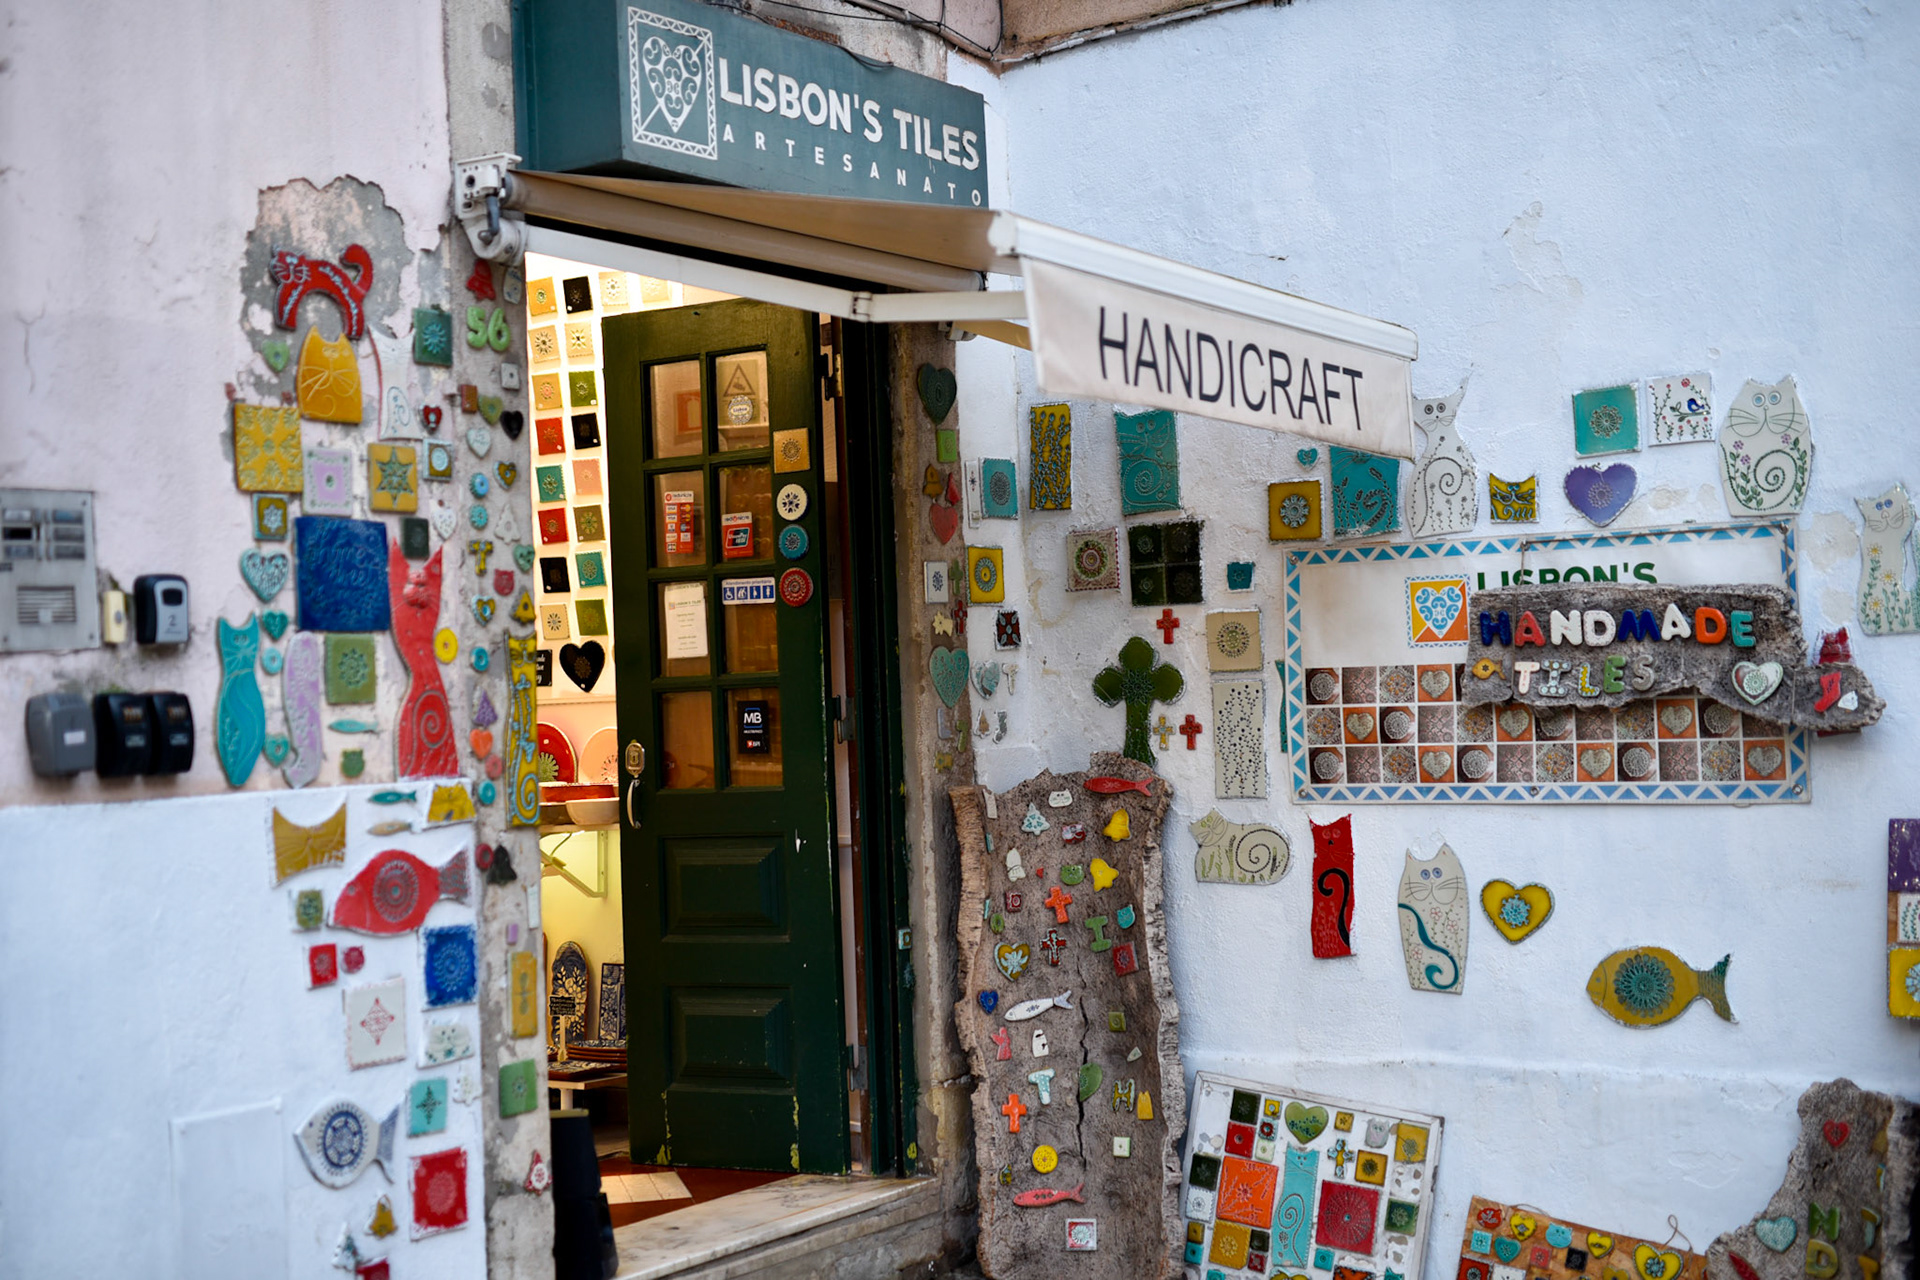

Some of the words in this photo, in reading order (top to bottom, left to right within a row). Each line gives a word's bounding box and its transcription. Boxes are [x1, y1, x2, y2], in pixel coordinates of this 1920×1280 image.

[718, 57, 883, 143] LISBON'S
[892, 108, 980, 171] TILES
[722, 123, 982, 207] ARTESANATO
[466, 305, 510, 352] 56
[1099, 305, 1363, 431] HANDICRAFT
[1479, 603, 1754, 647] HANDMADE
[1513, 653, 1658, 699] TILES
[743, 711, 762, 724] MB
